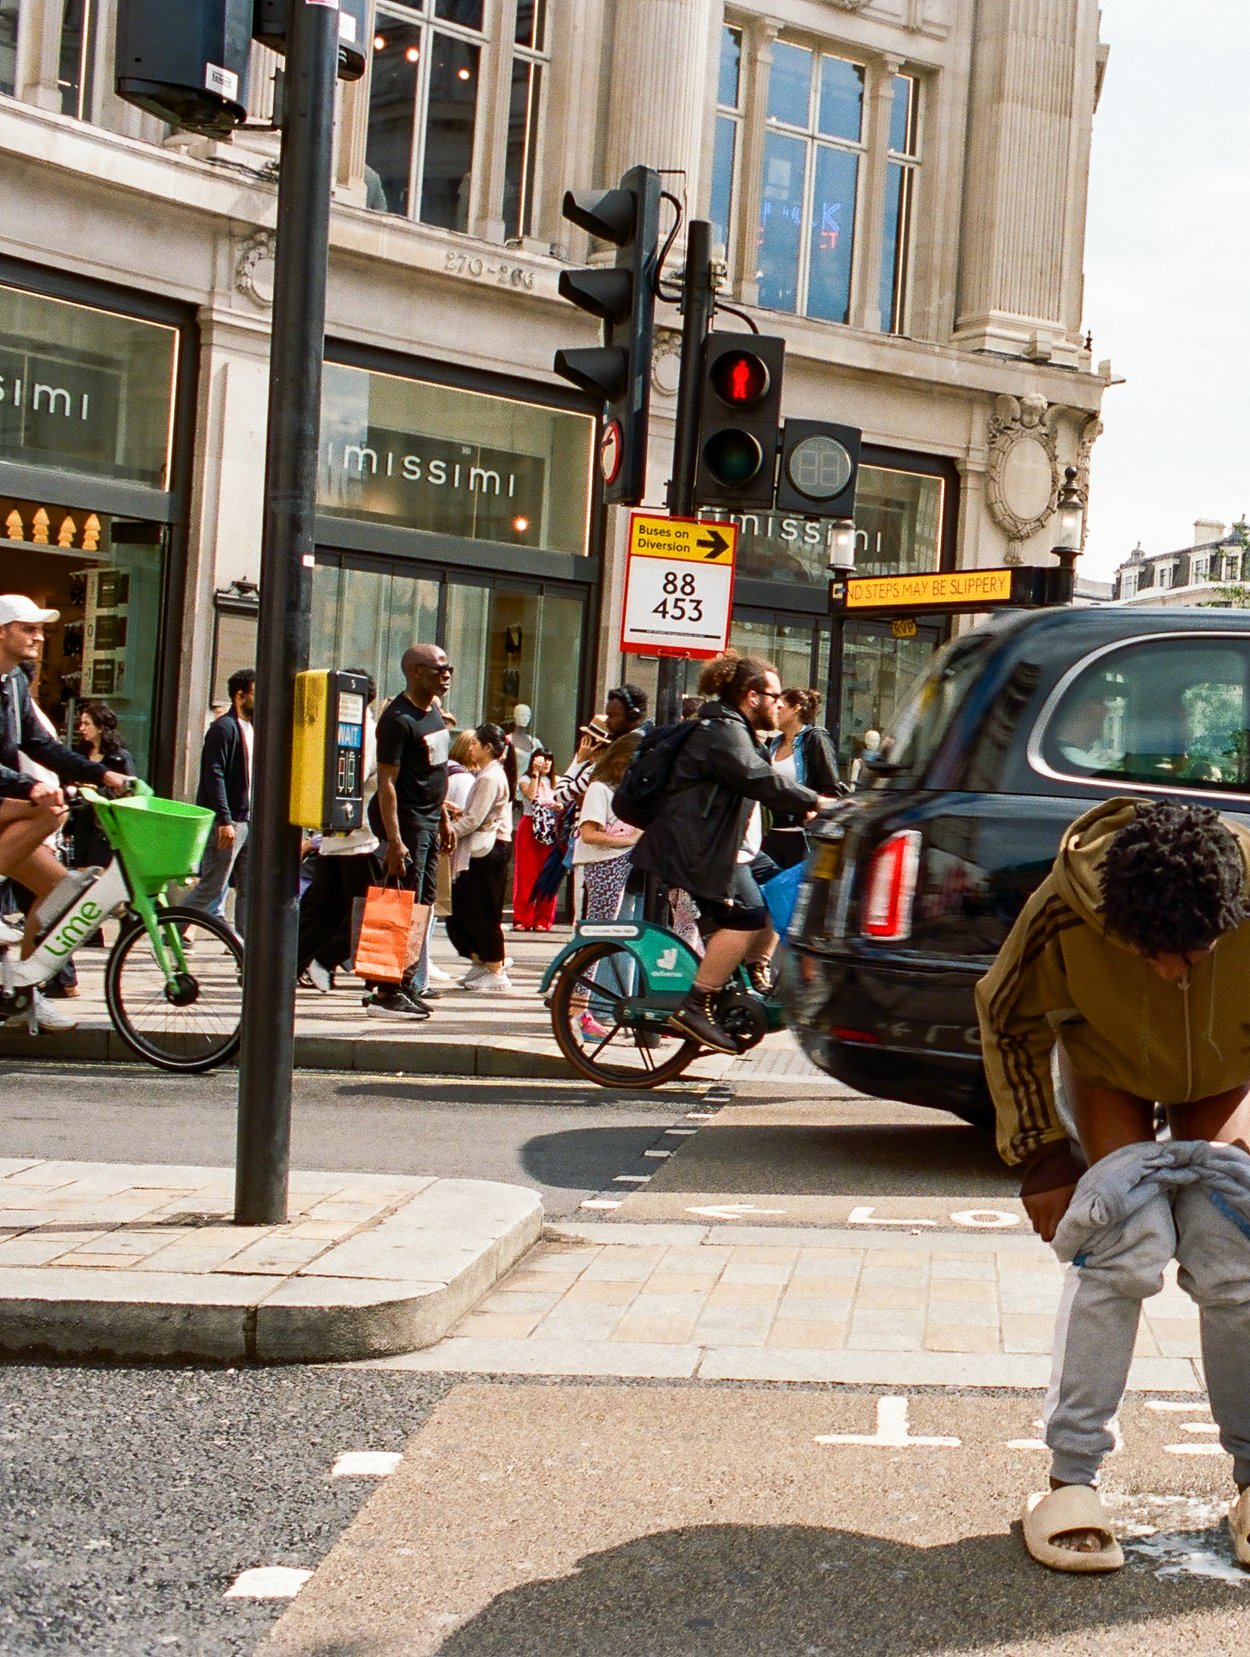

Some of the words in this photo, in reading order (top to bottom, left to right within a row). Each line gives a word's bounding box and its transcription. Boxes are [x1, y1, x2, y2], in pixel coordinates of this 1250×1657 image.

[638, 524, 672, 538] Buses
[674, 529, 689, 539] on
[637, 538, 691, 553] Diversion
[662, 571, 696, 597] 88
[865, 582, 900, 599] STEPS
[902, 580, 929, 597] MAY
[932, 579, 947, 596] BE
[950, 575, 1007, 595] SLIPPERY
[651, 597, 703, 622] 453
[44, 901, 102, 957] Lime
